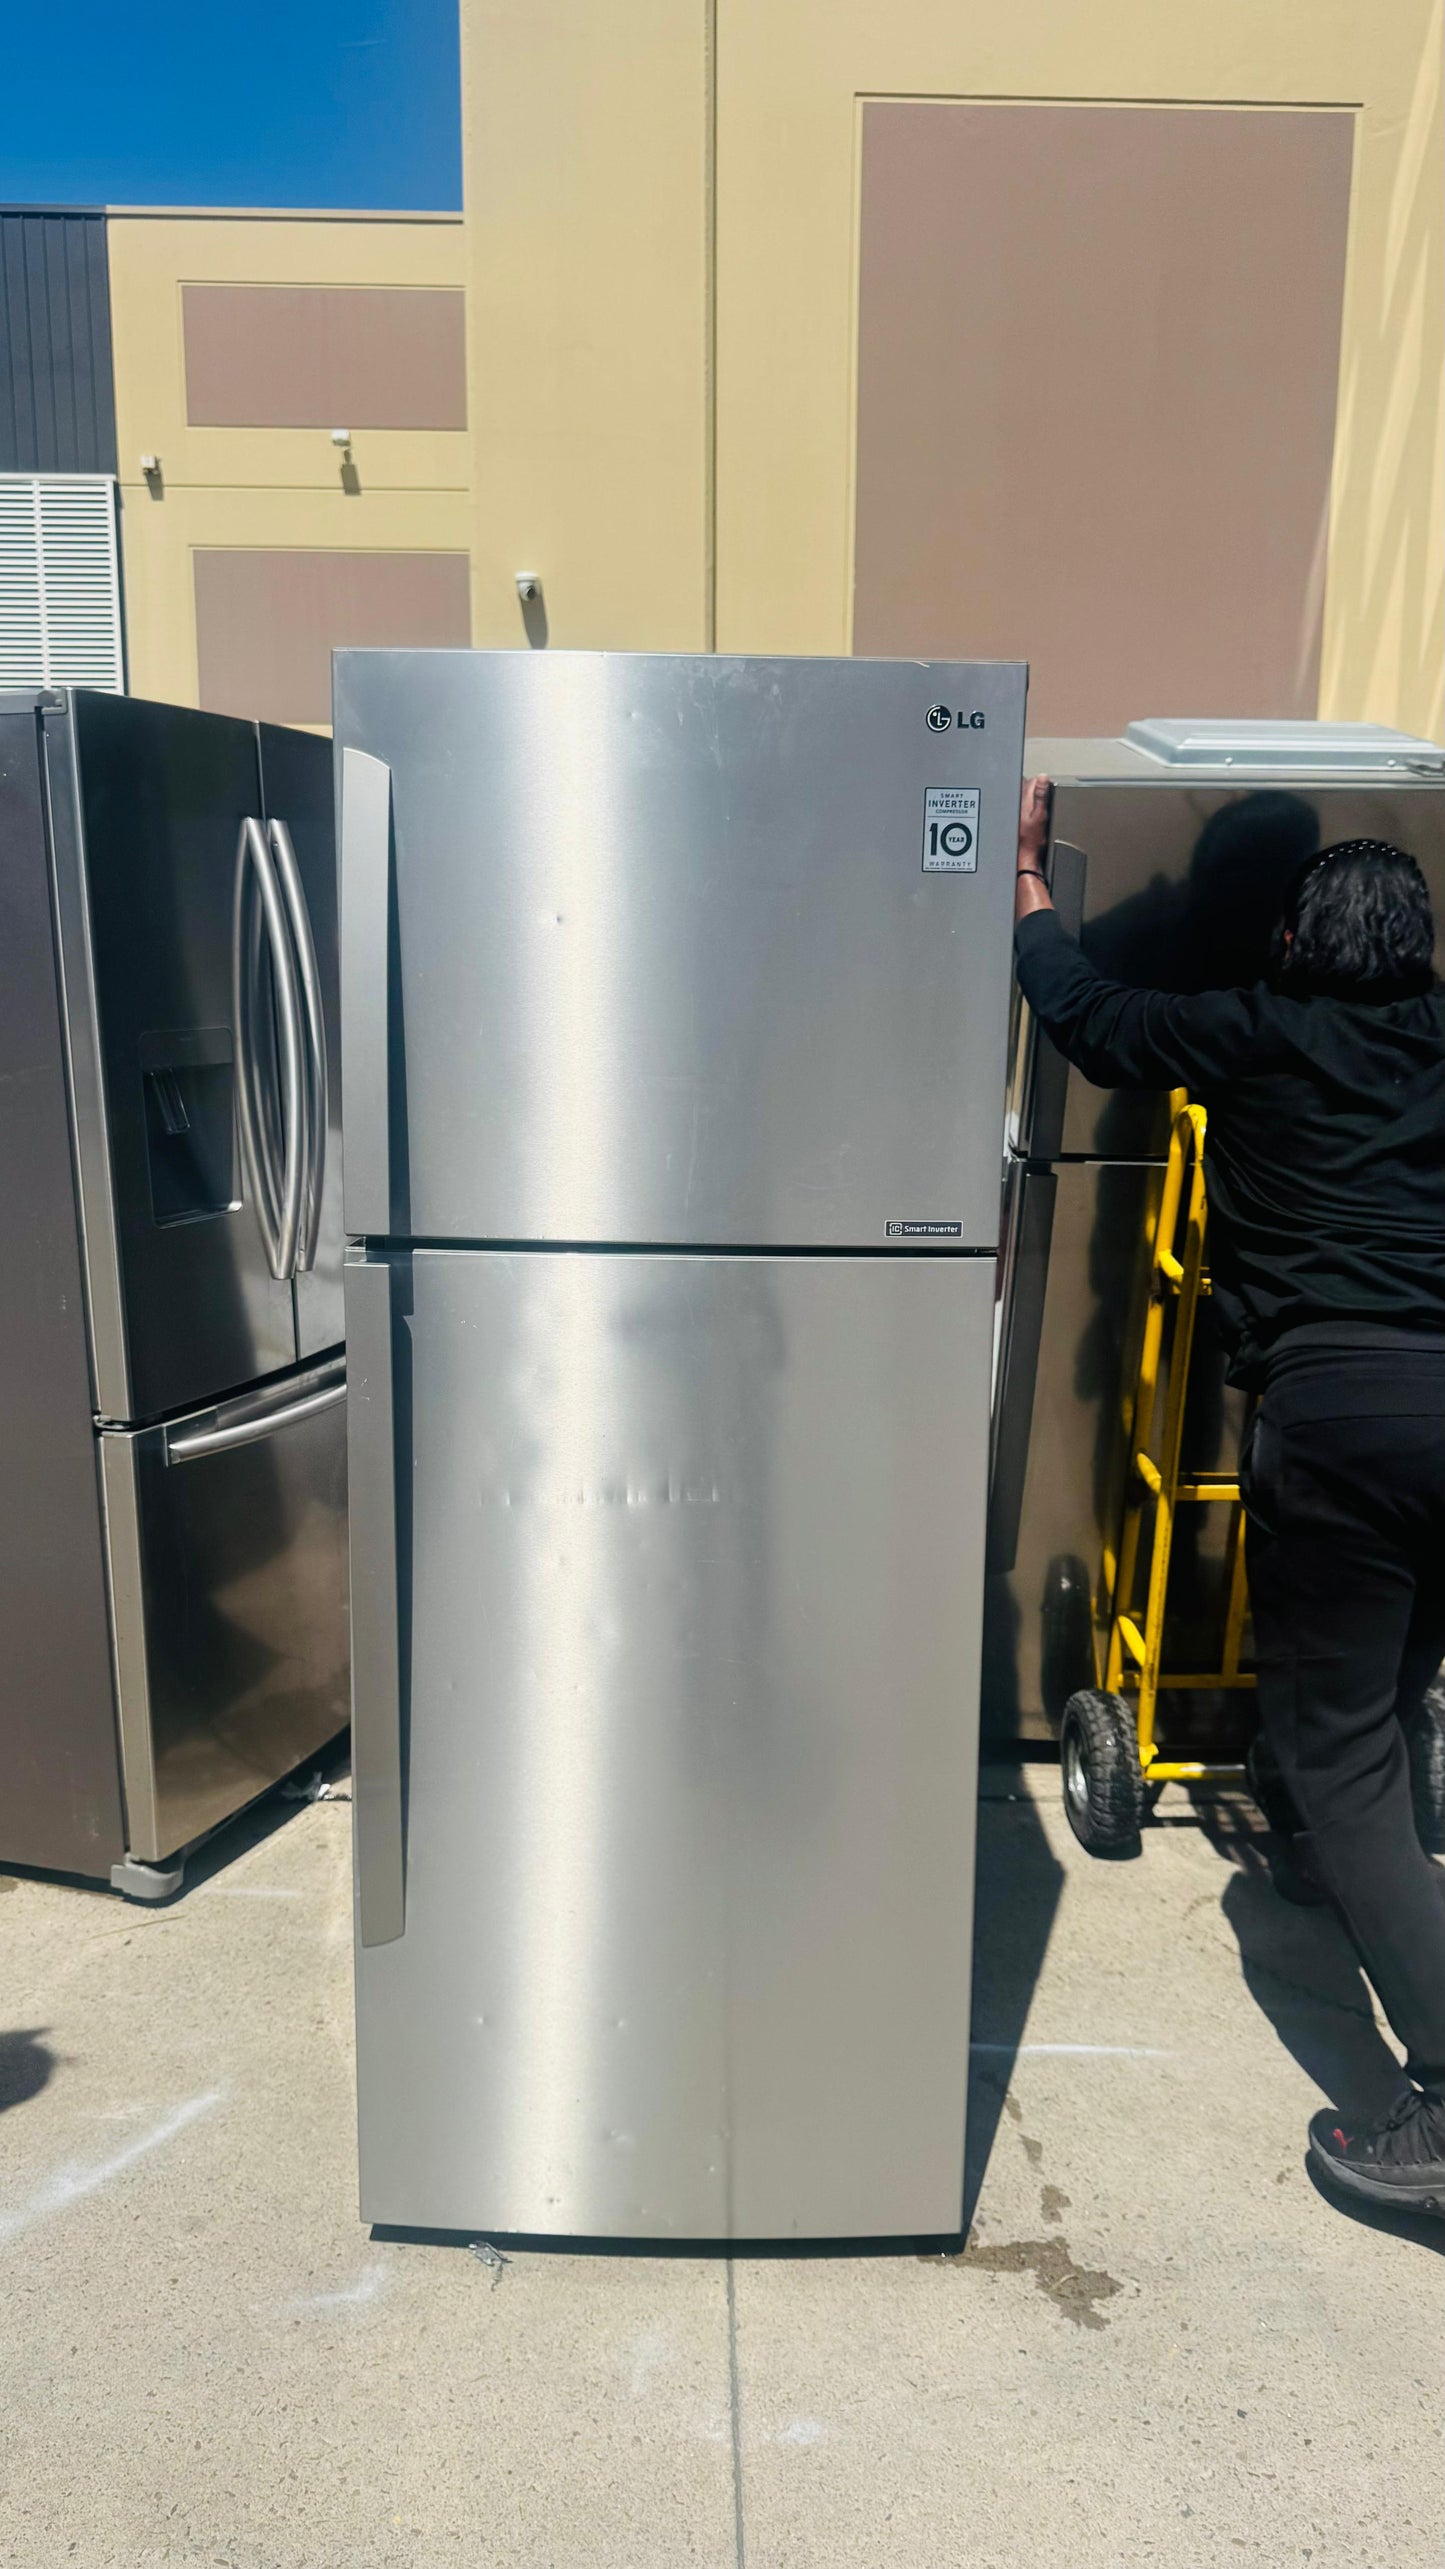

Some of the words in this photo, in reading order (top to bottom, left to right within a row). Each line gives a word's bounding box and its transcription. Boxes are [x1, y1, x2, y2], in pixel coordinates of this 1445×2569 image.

[957, 711, 985, 729] LG
[928, 800, 976, 809] INVERTER
[929, 822, 972, 857] 10
[904, 1225, 927, 1233] Smart
[928, 1225, 958, 1233] Inverter
